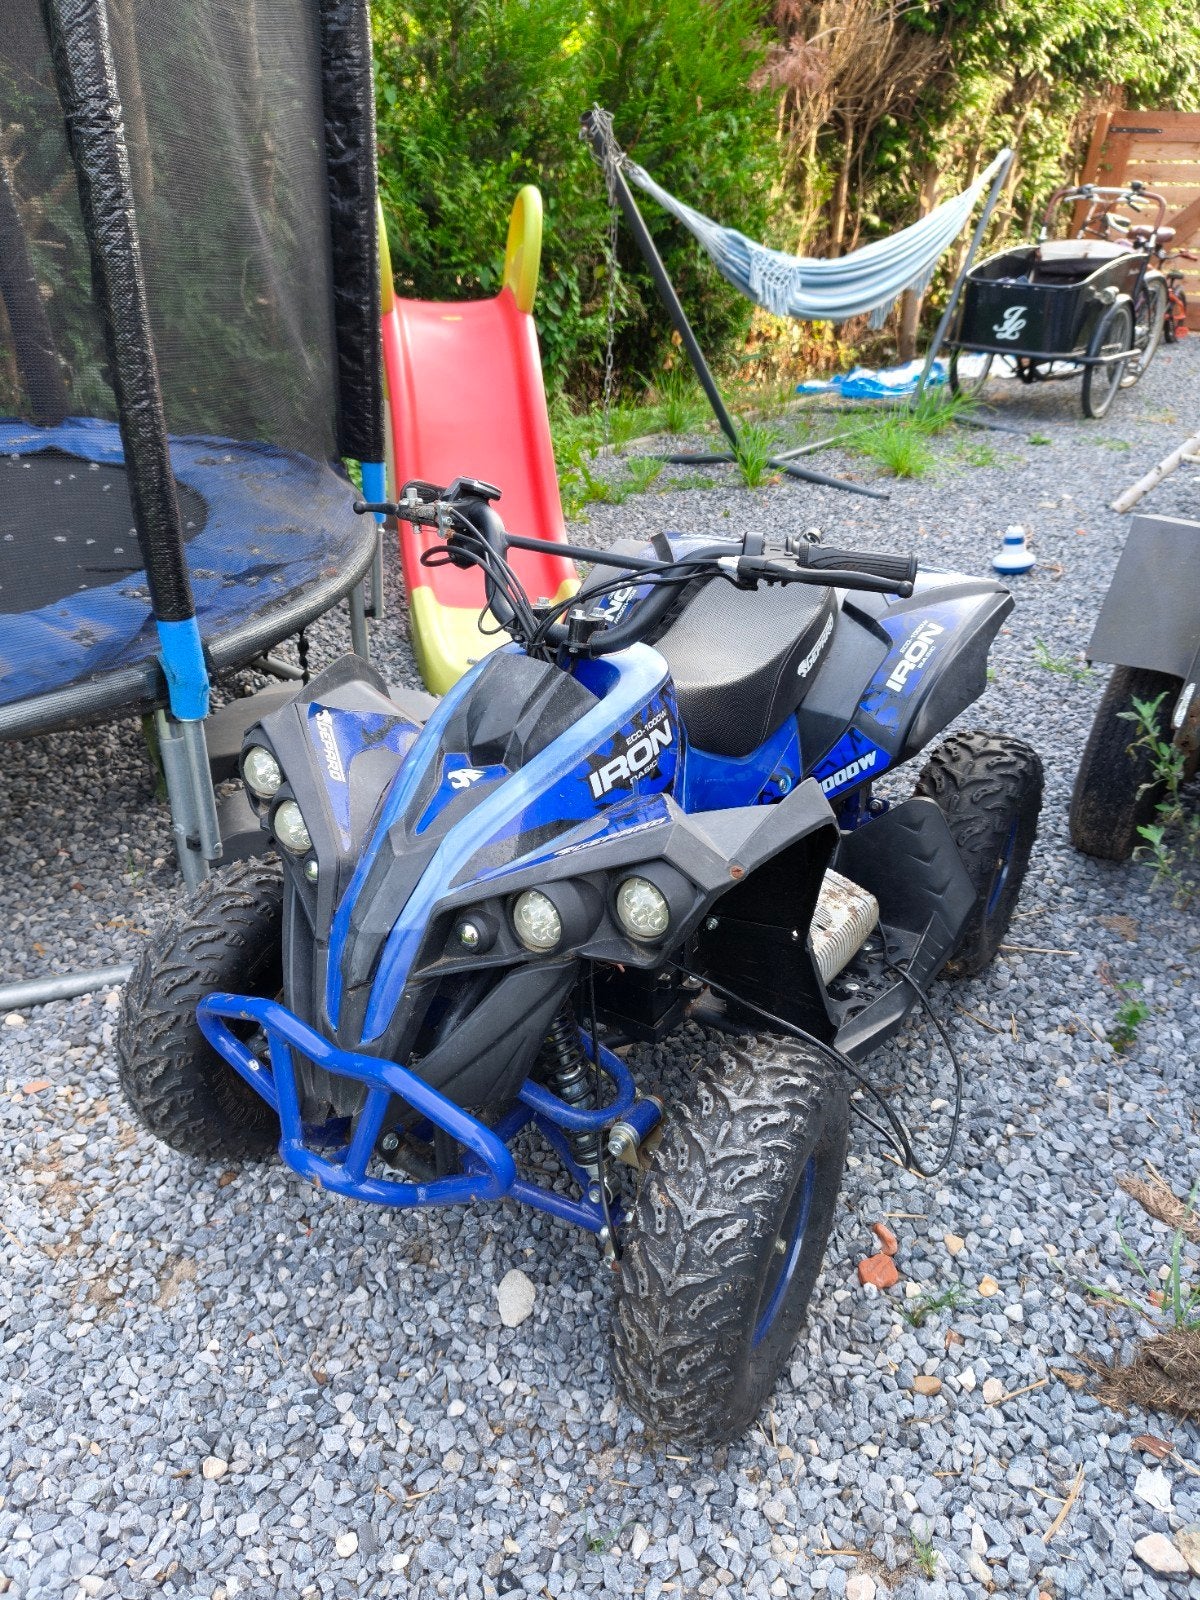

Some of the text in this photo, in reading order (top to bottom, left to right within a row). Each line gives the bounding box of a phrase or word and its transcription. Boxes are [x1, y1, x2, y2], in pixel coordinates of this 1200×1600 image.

[886, 622, 944, 692] IRON
[589, 719, 673, 799] IRON
[625, 708, 669, 746] ECO-1000W
